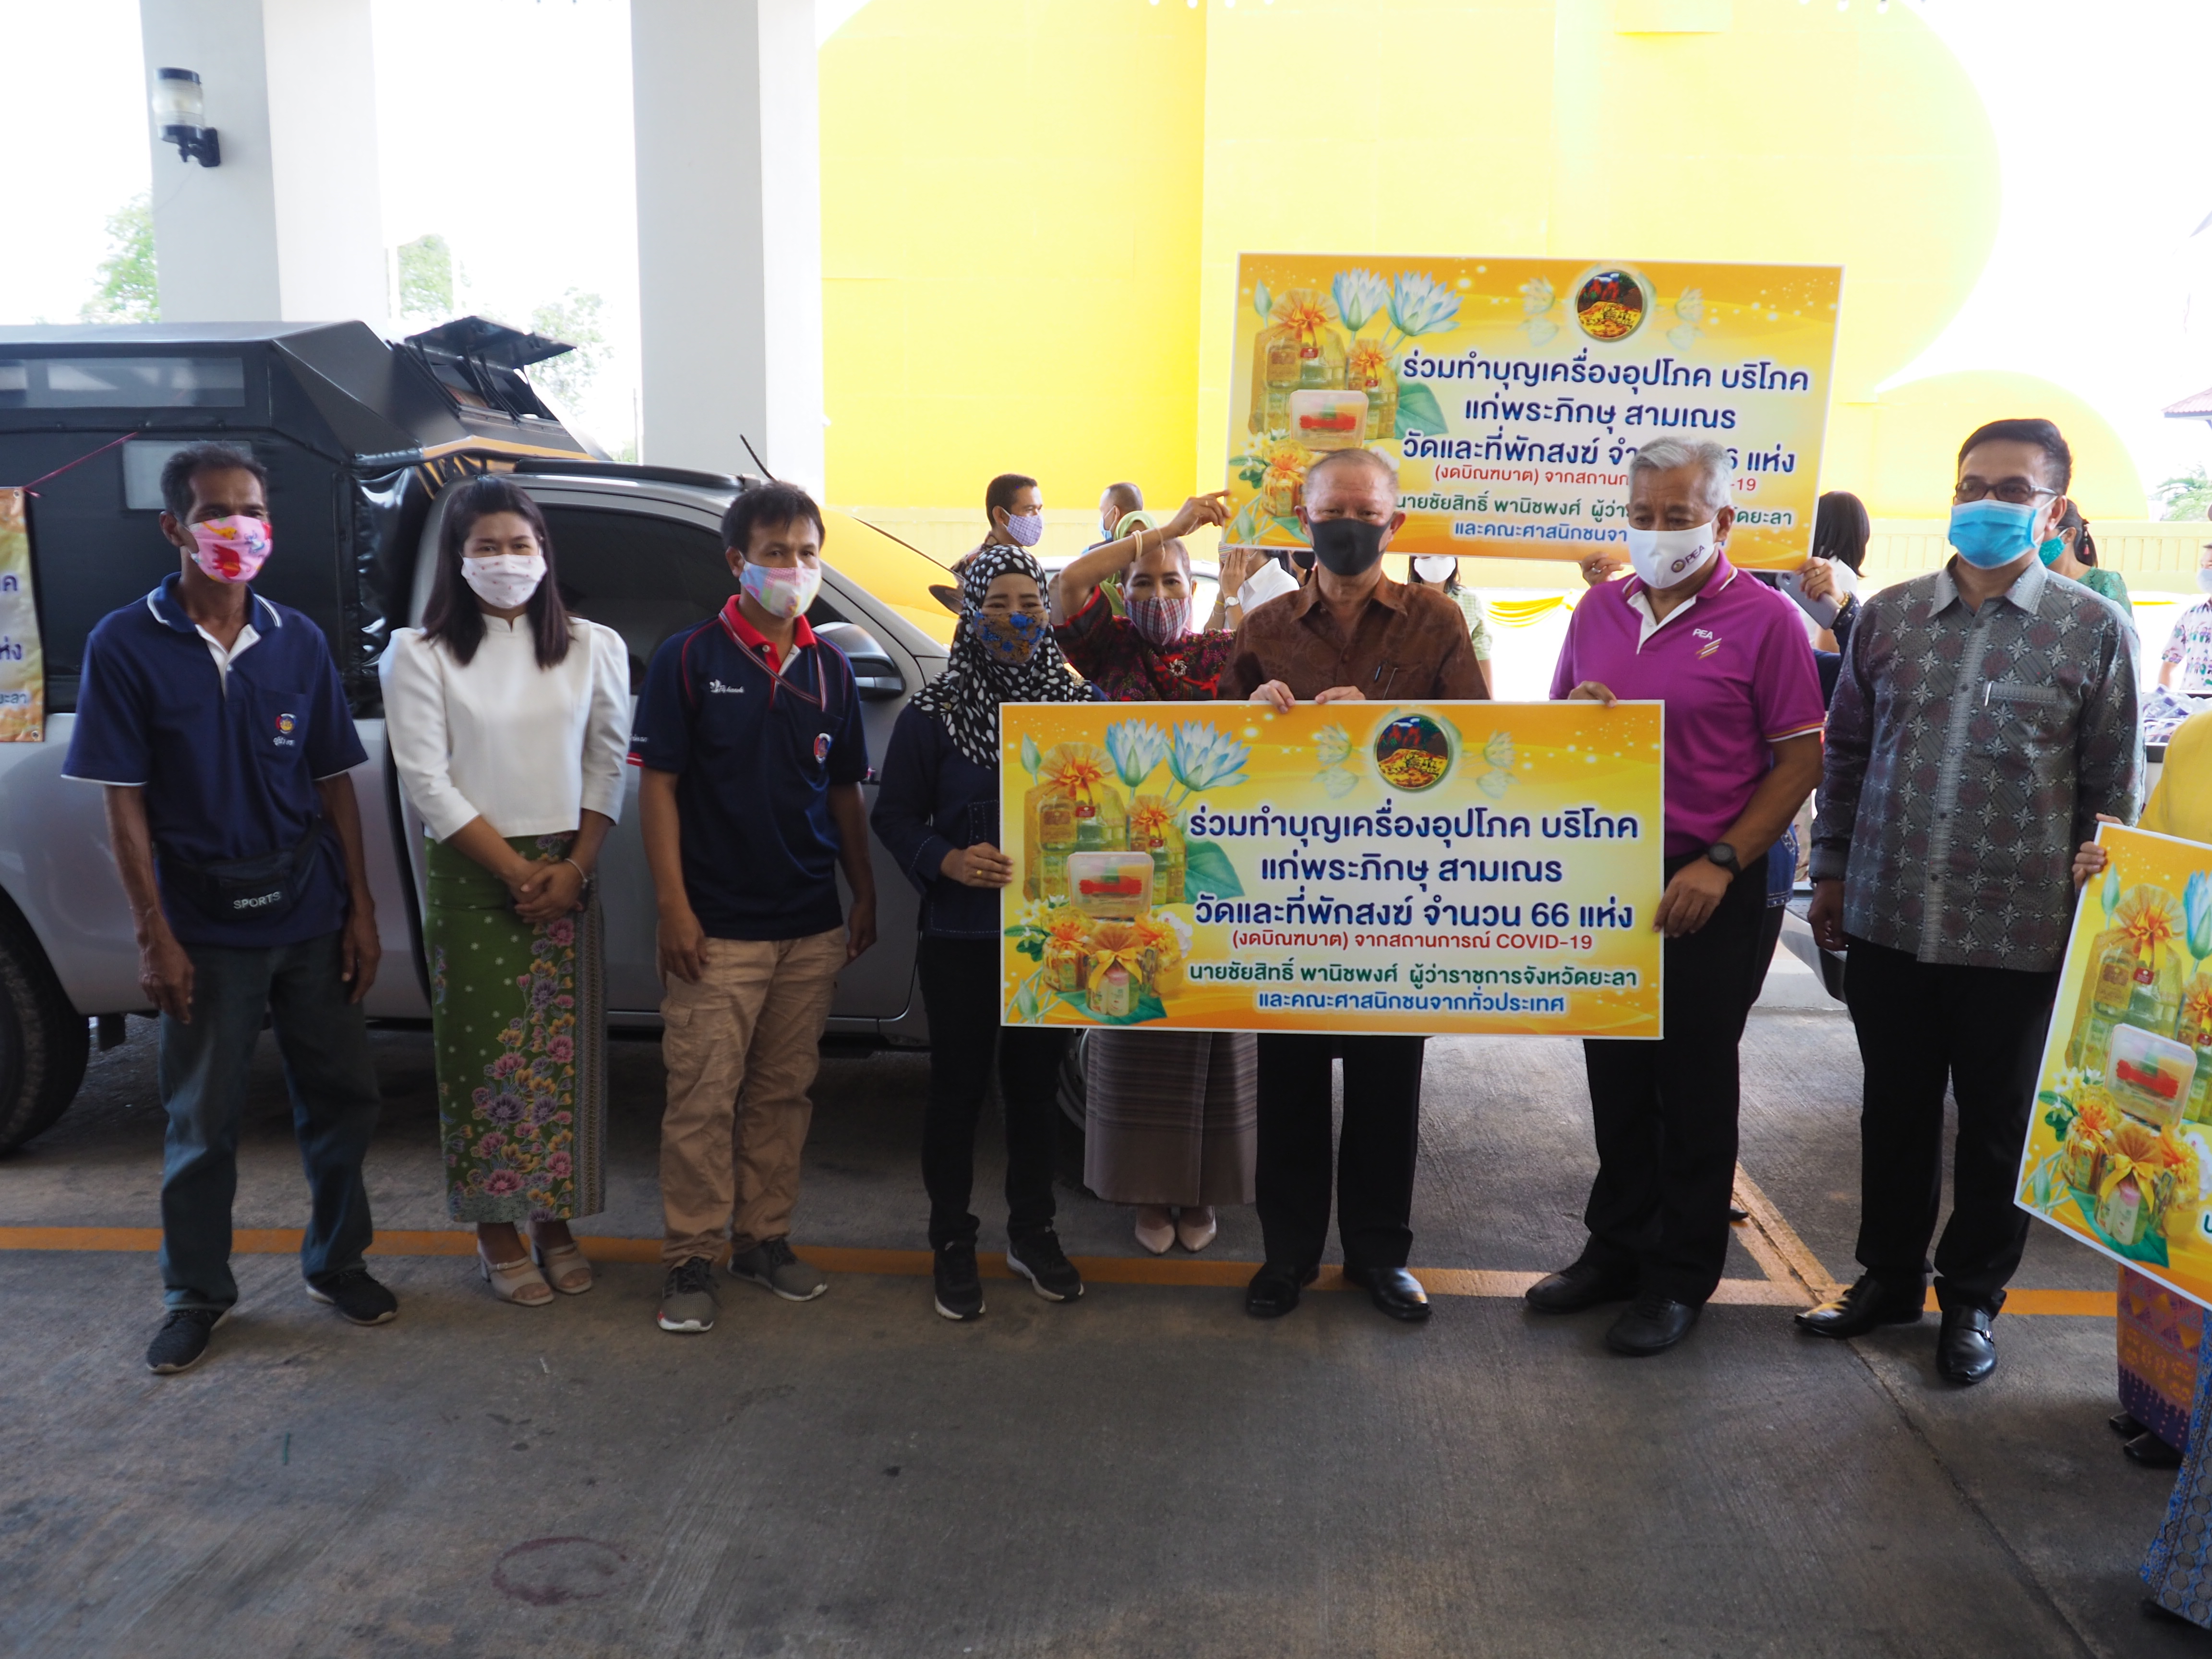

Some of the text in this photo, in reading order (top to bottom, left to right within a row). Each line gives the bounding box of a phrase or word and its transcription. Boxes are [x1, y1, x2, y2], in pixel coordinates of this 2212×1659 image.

[1403, 347, 1808, 395] ร่วมทำบุญเครื่องอุปโภค บริโภค
[1466, 391, 1736, 434] แก่พระภิกษุ สามเณร
[1403, 425, 1601, 465] วัดและที่พักสงฆ์
[1747, 443, 1795, 472] แห่ง
[1435, 464, 1629, 485] (งดบิณฑบาต) จากสถานก
[1494, 497, 1582, 516] พานิชพงศ์
[1685, 545, 1705, 564] PEA
[1692, 628, 1713, 639] PEA
[1190, 798, 1638, 848] ร่วมทำบุญเครื่องอุปโภค บริโภค
[1262, 849, 1563, 892] แก่พระภิกษุ สามเณร
[233, 891, 281, 909] SPORTS
[1196, 886, 1633, 928] วัดและที่พักสงฆ์ จำนวน 66 แห่ง
[1232, 929, 1593, 950] (งดบิณฑบาต) จากสถานการณ์ COVID-19
[1190, 957, 1637, 989] นายชัยสิทธิ์ พานิชพงศ์ ผู้ว่าราชการจังหวัดยะลา
[1259, 986, 1564, 1012] และคณะศาสนิกชนจากทั่วประเทศ
